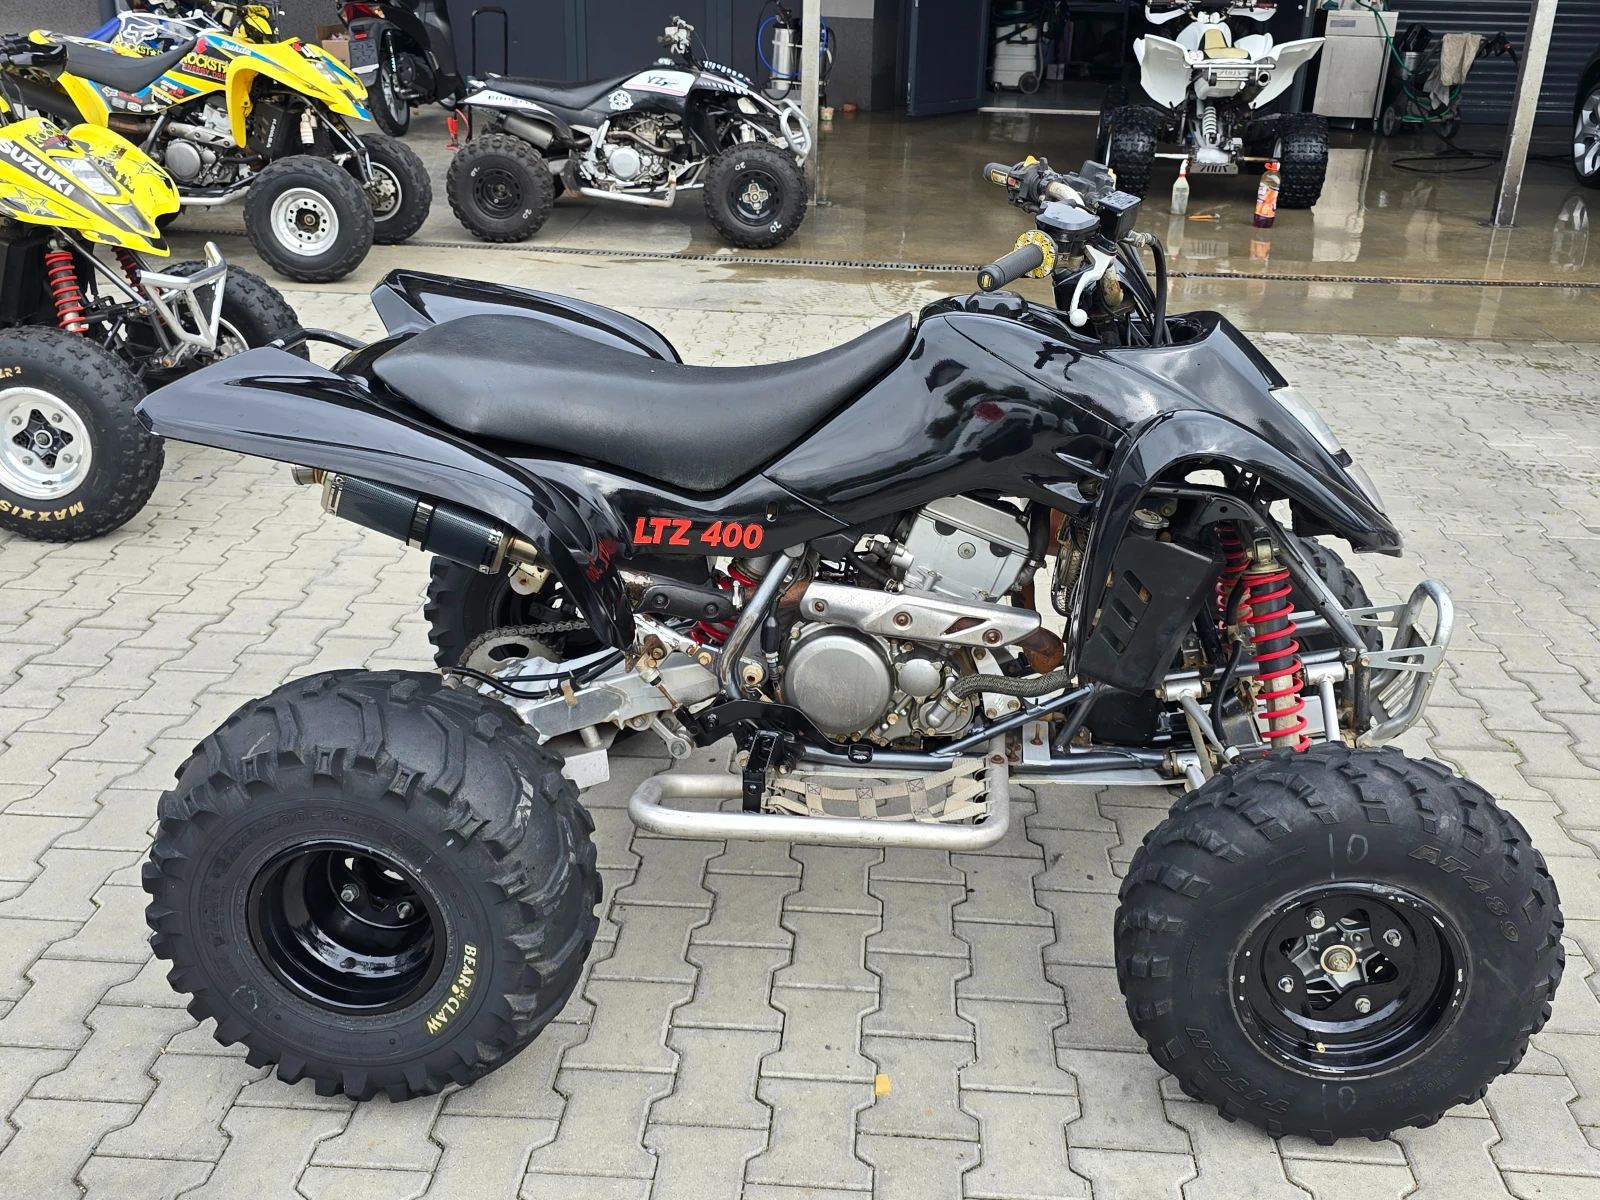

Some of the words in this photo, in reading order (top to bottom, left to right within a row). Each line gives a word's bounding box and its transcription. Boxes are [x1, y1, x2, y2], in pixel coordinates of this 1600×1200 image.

[0, 139, 76, 197] SUZUKI
[770, 221, 782, 233] 20
[0, 499, 85, 522] MAXXIS
[633, 516, 694, 546] LTZ
[700, 520, 765, 550] 400
[1327, 832, 1369, 880] 10
[1407, 844, 1519, 942] AT489
[457, 943, 477, 988] BEAR
[426, 996, 460, 1035] CLAW
[1184, 1026, 1291, 1114] TITAN
